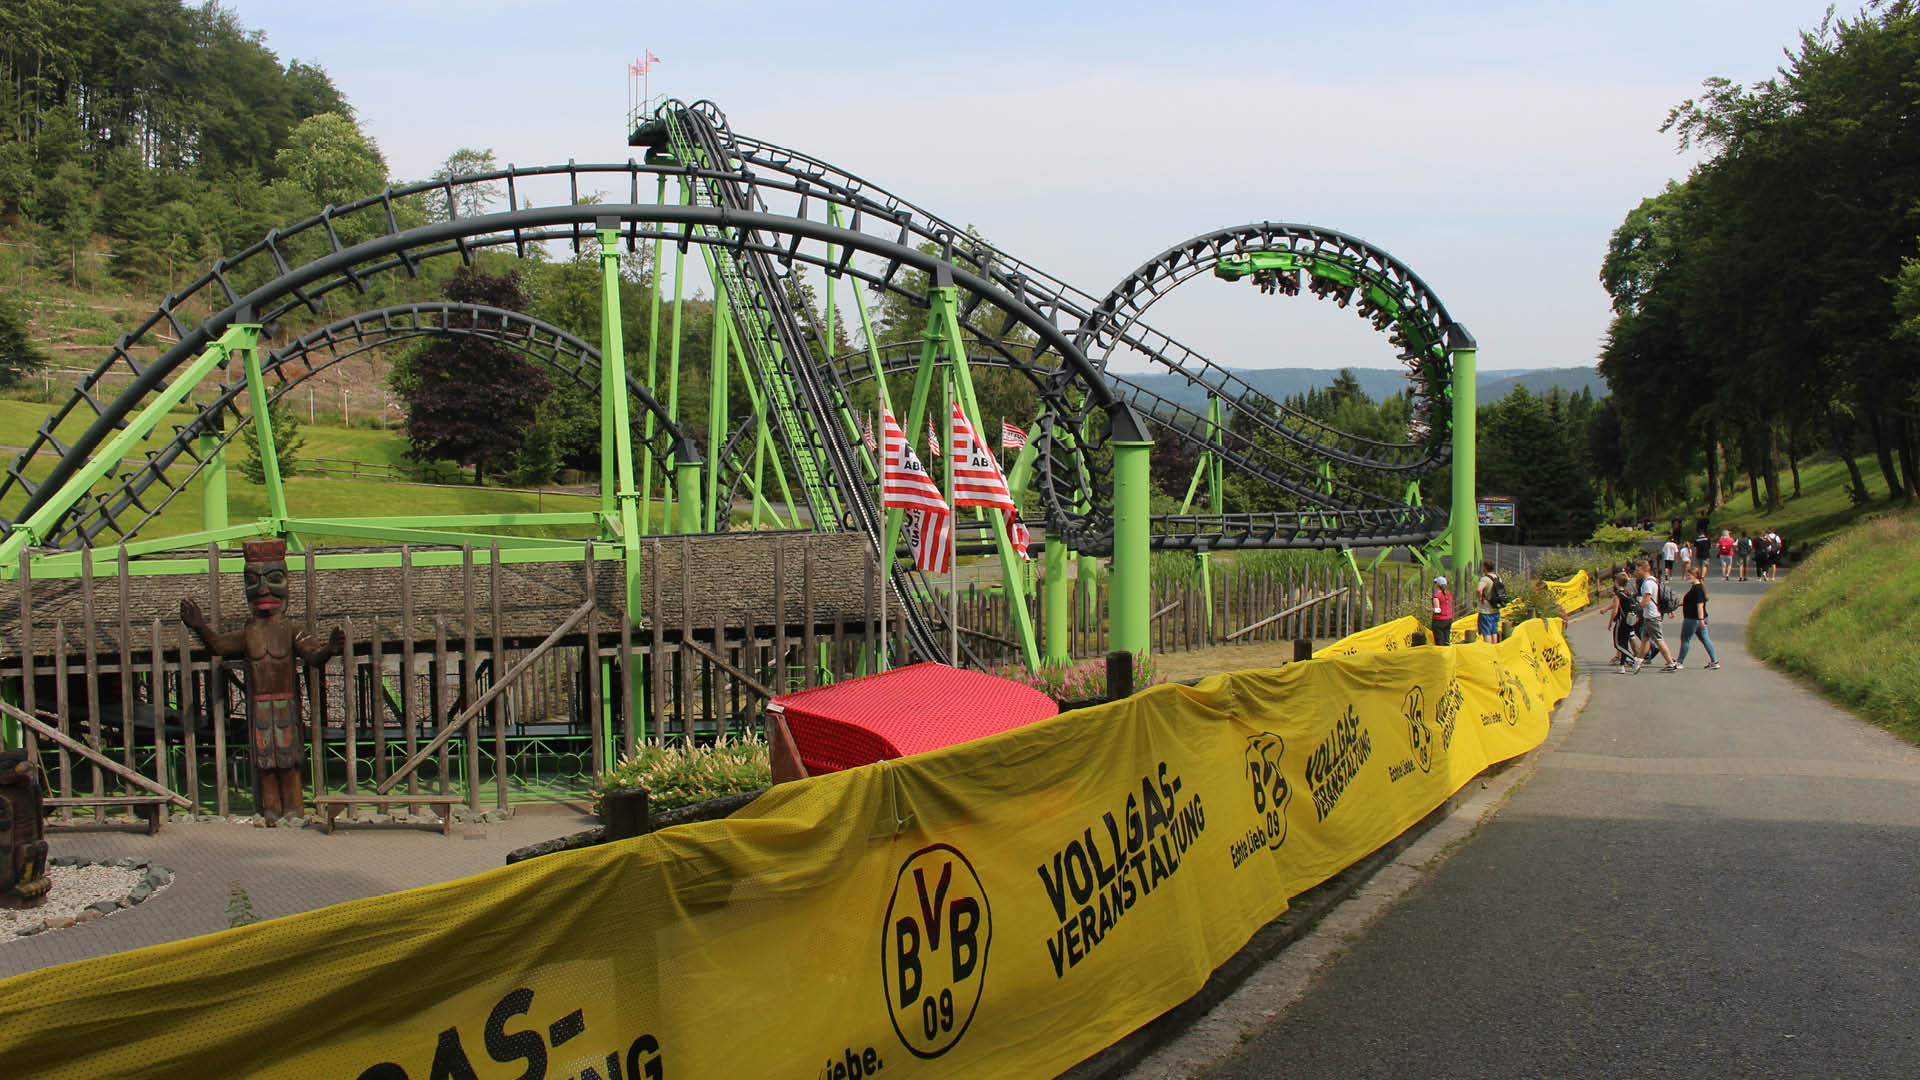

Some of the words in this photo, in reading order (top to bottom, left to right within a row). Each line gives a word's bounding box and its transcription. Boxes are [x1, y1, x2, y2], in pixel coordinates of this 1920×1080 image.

[1036, 761, 1182, 924] VOLLGAS-
[1266, 810, 1280, 839] 09
[1046, 793, 1206, 979] VERANSTALTUNG
[895, 860, 981, 1011] BVB
[354, 988, 586, 1080] AS-
[922, 987, 954, 1042] 09
[818, 1046, 883, 1080] iebe.
